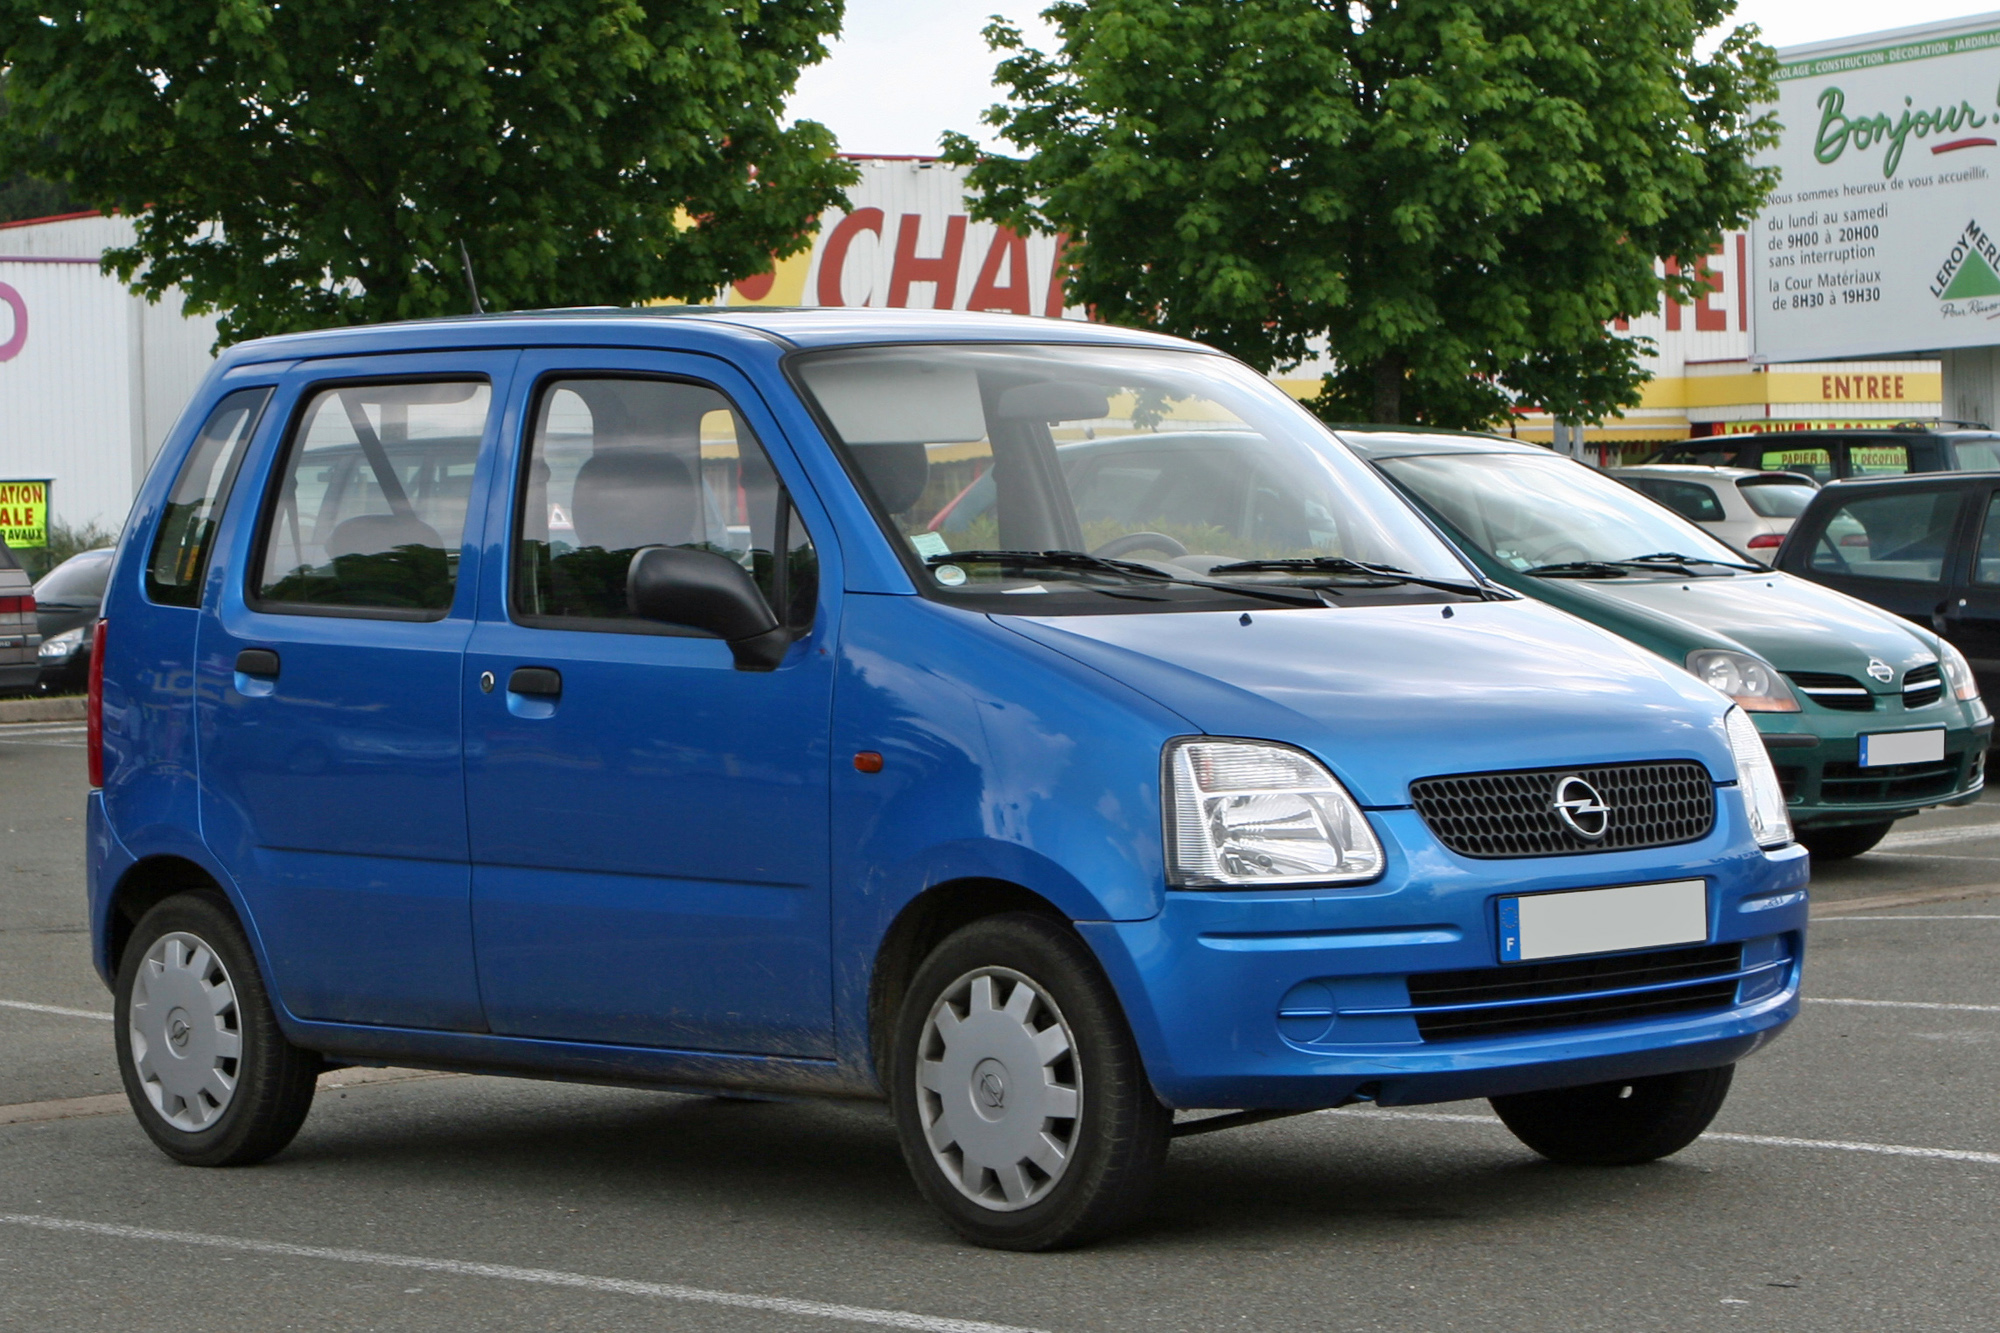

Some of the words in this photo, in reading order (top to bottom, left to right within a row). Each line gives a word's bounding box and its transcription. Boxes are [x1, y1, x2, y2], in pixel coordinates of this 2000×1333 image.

[1815, 52, 1885, 72] CONSTRUCTION
[1814, 86, 1986, 179] Bonjour
[1767, 194, 1793, 205] Nous
[1797, 188, 1839, 202] sommes
[1843, 182, 1887, 196] heureux
[1890, 177, 1904, 190] de
[1908, 175, 1934, 188] vous
[1937, 166, 1989, 184] accueillir,
[1768, 216, 1783, 231] du
[1788, 211, 1818, 229] lundi
[1823, 212, 1838, 224] au
[1843, 202, 1888, 222] samedi
[1768, 236, 1783, 250] de
[1787, 231, 1819, 248] 9H00
[1824, 229, 1832, 244] à
[1839, 225, 1879, 242] 20H00
[1769, 253, 1795, 268] sans
[1800, 244, 1875, 265] interruption
[1929, 233, 1969, 298] LEROY
[1769, 278, 1779, 292] la
[1785, 276, 1813, 291] Cour
[1817, 269, 1881, 288] Matériaux
[1772, 296, 1787, 311] de
[1792, 293, 1824, 309] 8H30
[1829, 290, 1837, 305] à
[1842, 287, 1880, 304] 19H30
[1822, 375, 1904, 399] ENTREE
[1781, 452, 1817, 465] PAPIER
[0, 485, 43, 503] ATION
[0, 507, 34, 526] ALE
[1506, 937, 1515, 951] F
